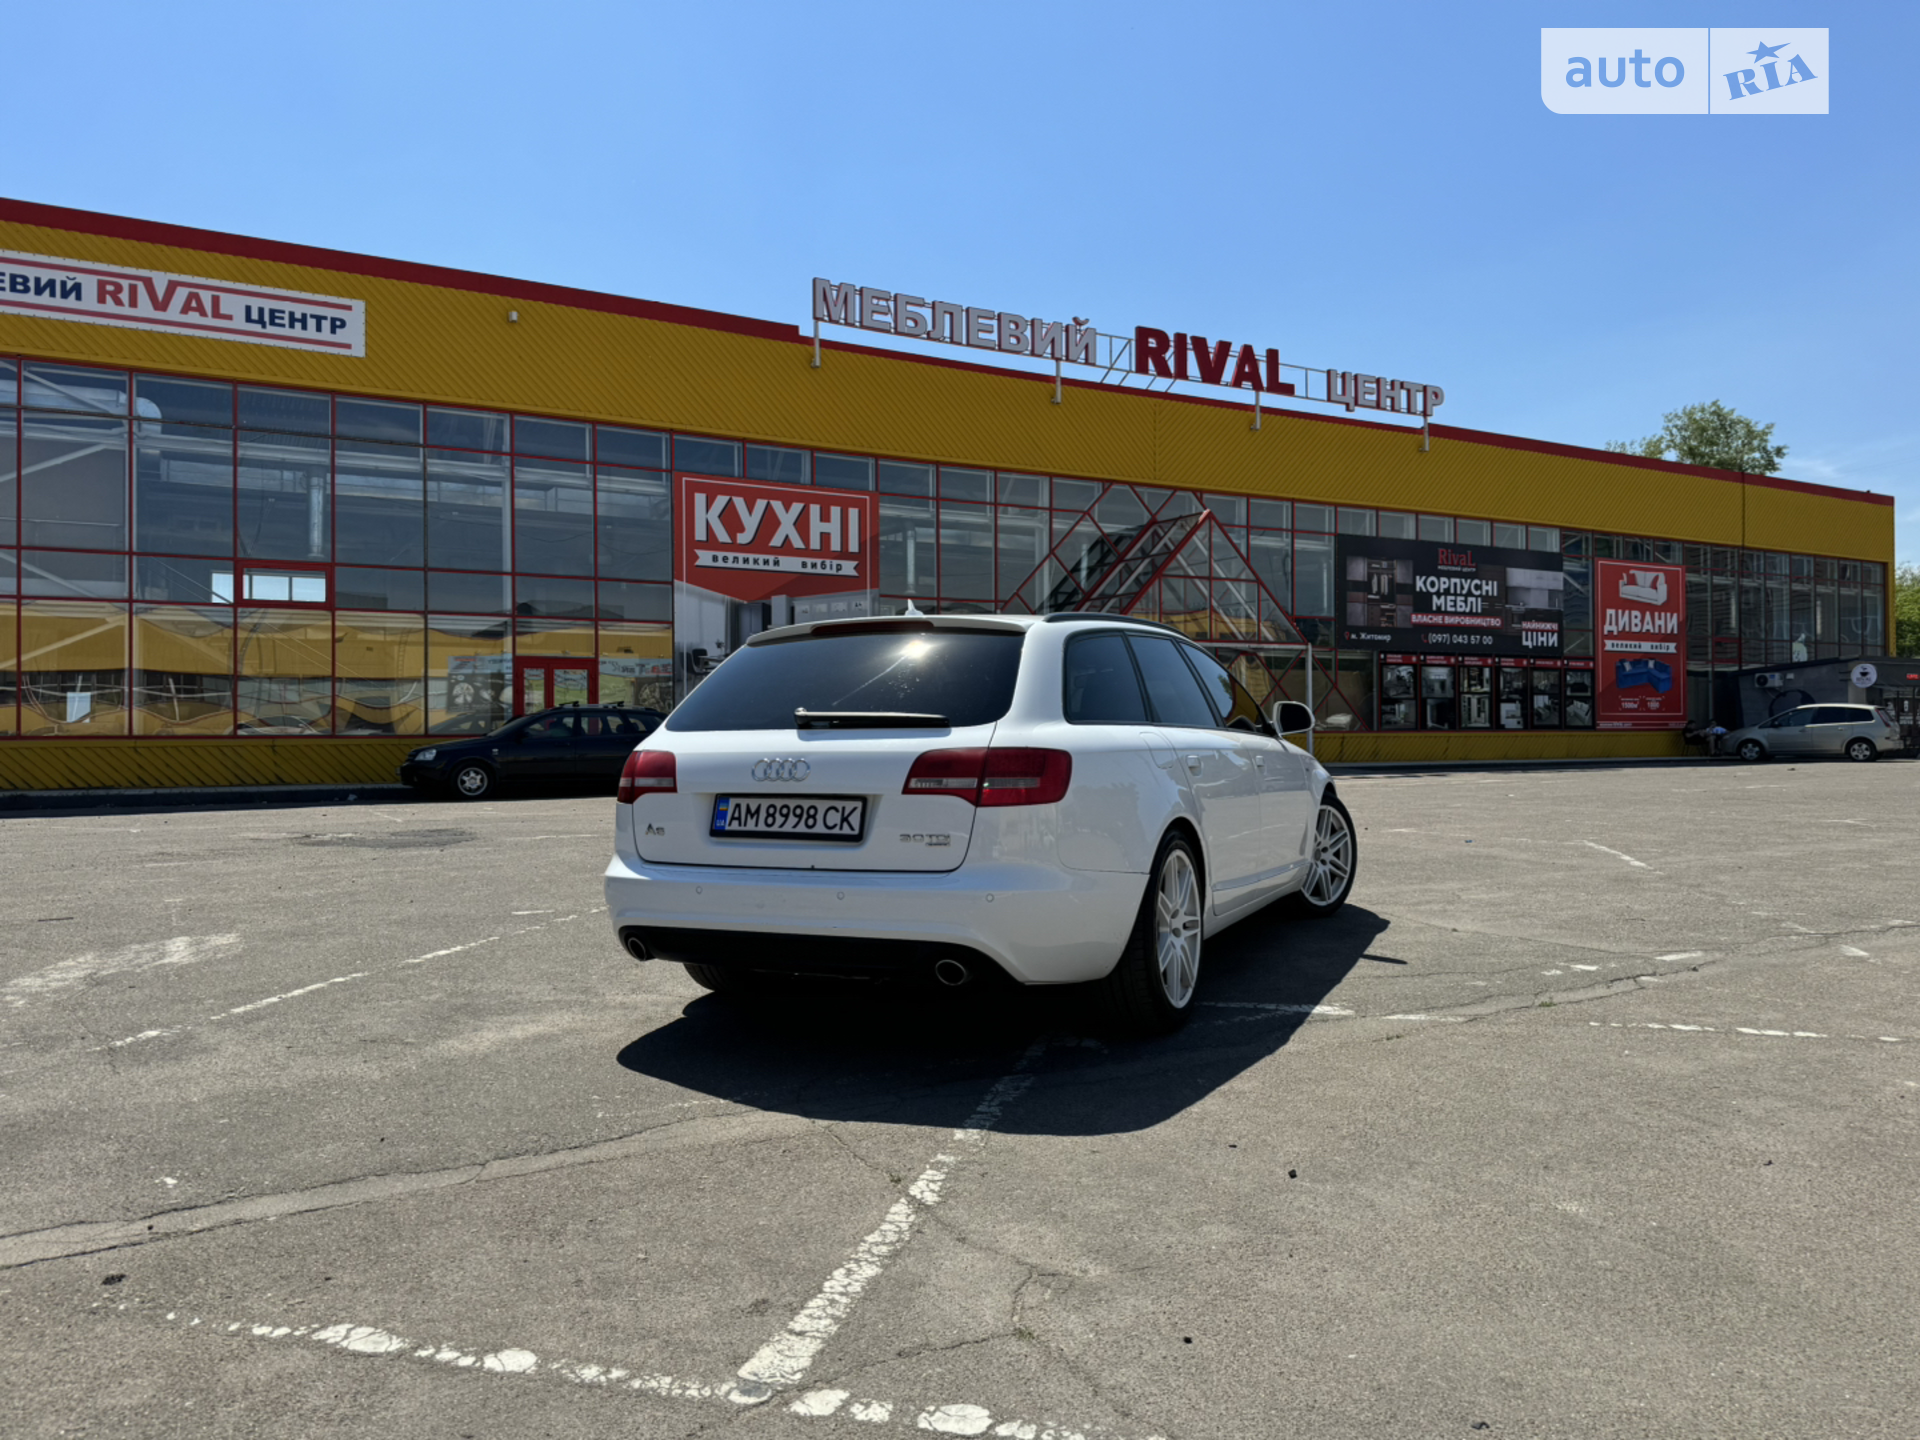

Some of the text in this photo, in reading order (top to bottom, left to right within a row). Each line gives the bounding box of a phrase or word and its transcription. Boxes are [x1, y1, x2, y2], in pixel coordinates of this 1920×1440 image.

[96, 277, 234, 322] RIVAL
[244, 304, 347, 335] ЦЕНТР
[812, 277, 1445, 417] МЕБЛЕВИЙ RIVAL ЦЕНТР
[694, 492, 860, 553] КУХНІ
[711, 553, 843, 573] великий вибір
[1415, 575, 1498, 597] КОРПУСНІ
[1432, 594, 1482, 613] МЕБЛІ
[1411, 614, 1501, 627] ВЛАСНЕ ВИРОБНИЦТВО
[1603, 608, 1678, 636] ДИВАНИ
[1360, 632, 1392, 643] Житомир
[1428, 632, 1493, 645] (097) 043 57 00
[1522, 631, 1558, 649] ЦІНИ
[1650, 643, 1670, 652] вибір
[764, 804, 818, 830] 8998
